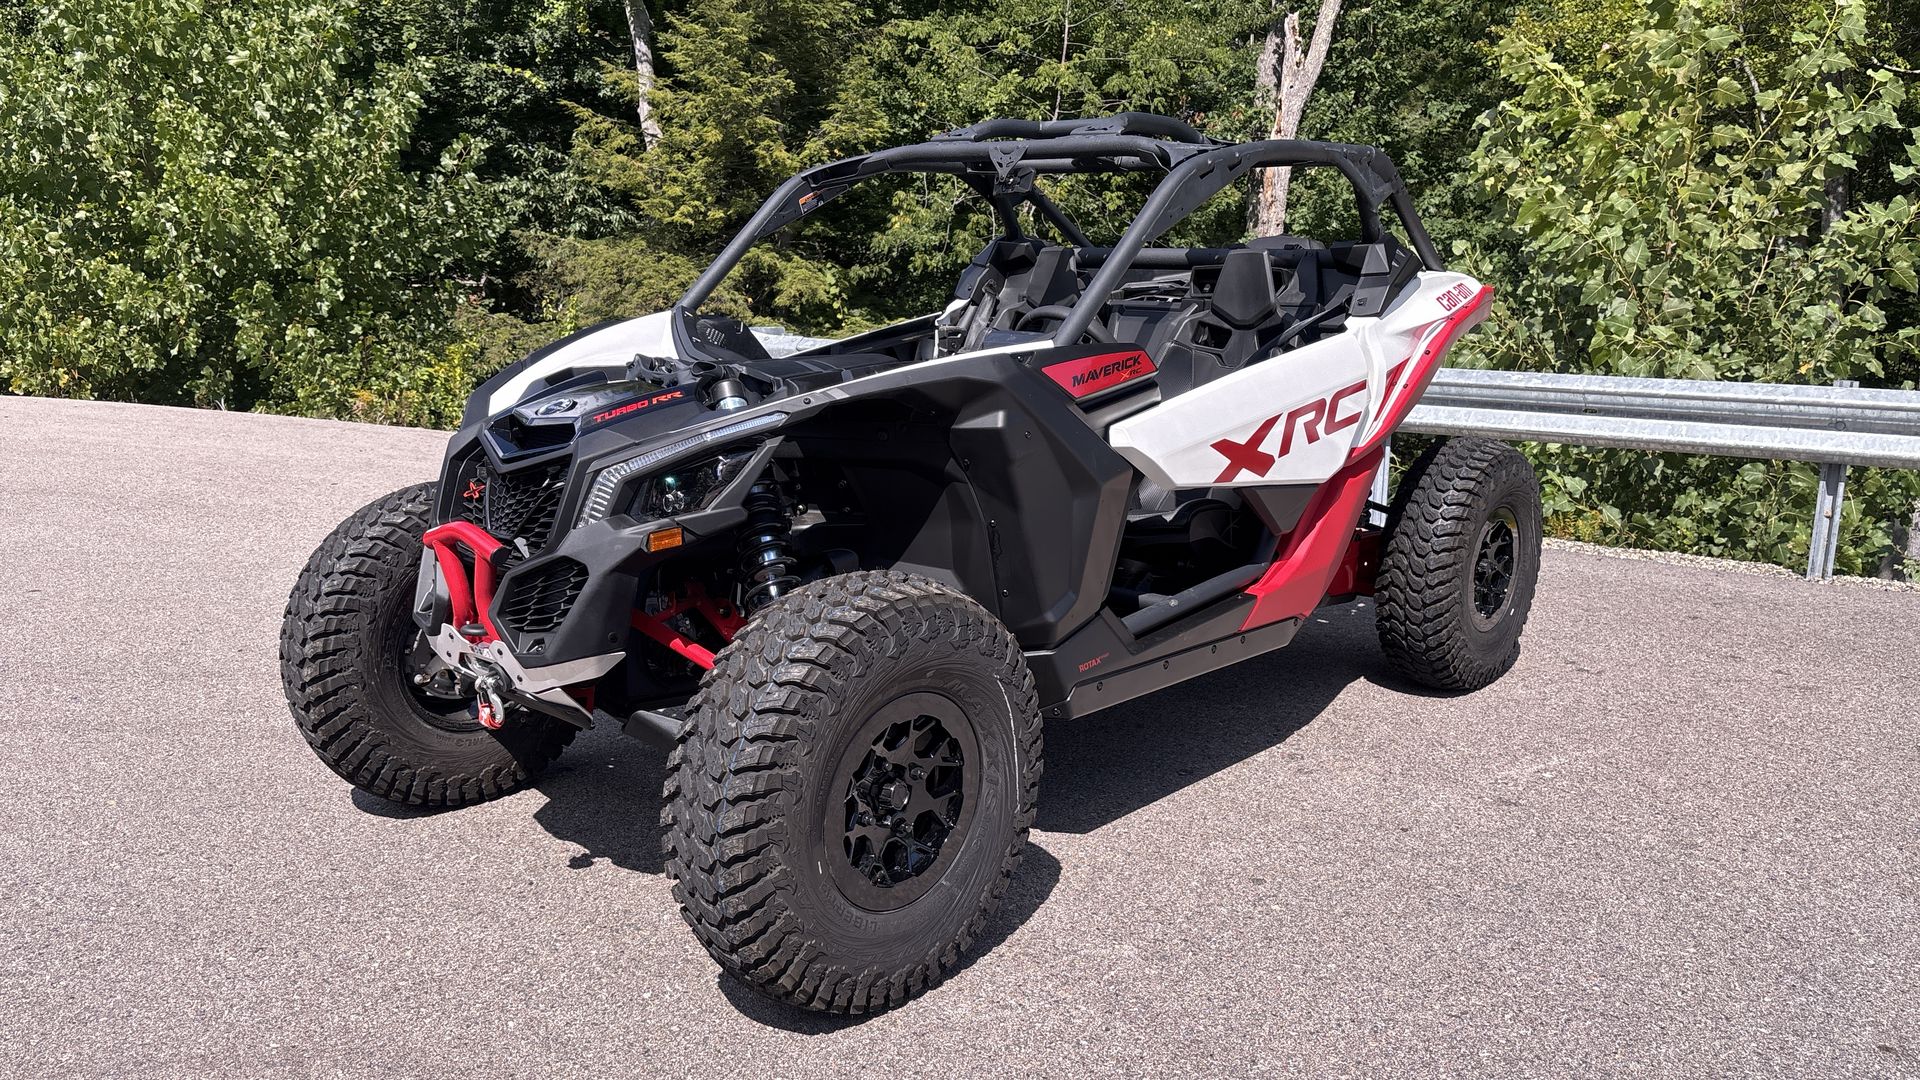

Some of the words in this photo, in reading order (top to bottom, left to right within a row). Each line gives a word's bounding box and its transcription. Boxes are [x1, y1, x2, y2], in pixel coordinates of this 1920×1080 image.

[1436, 282, 1474, 312] can-am
[1072, 354, 1142, 387] MAVERICK
[1120, 368, 1142, 381] XRC
[593, 399, 649, 422] TURBO
[652, 391, 684, 404] RR
[1209, 379, 1367, 484] XRC
[1078, 656, 1102, 672] ROTAX
